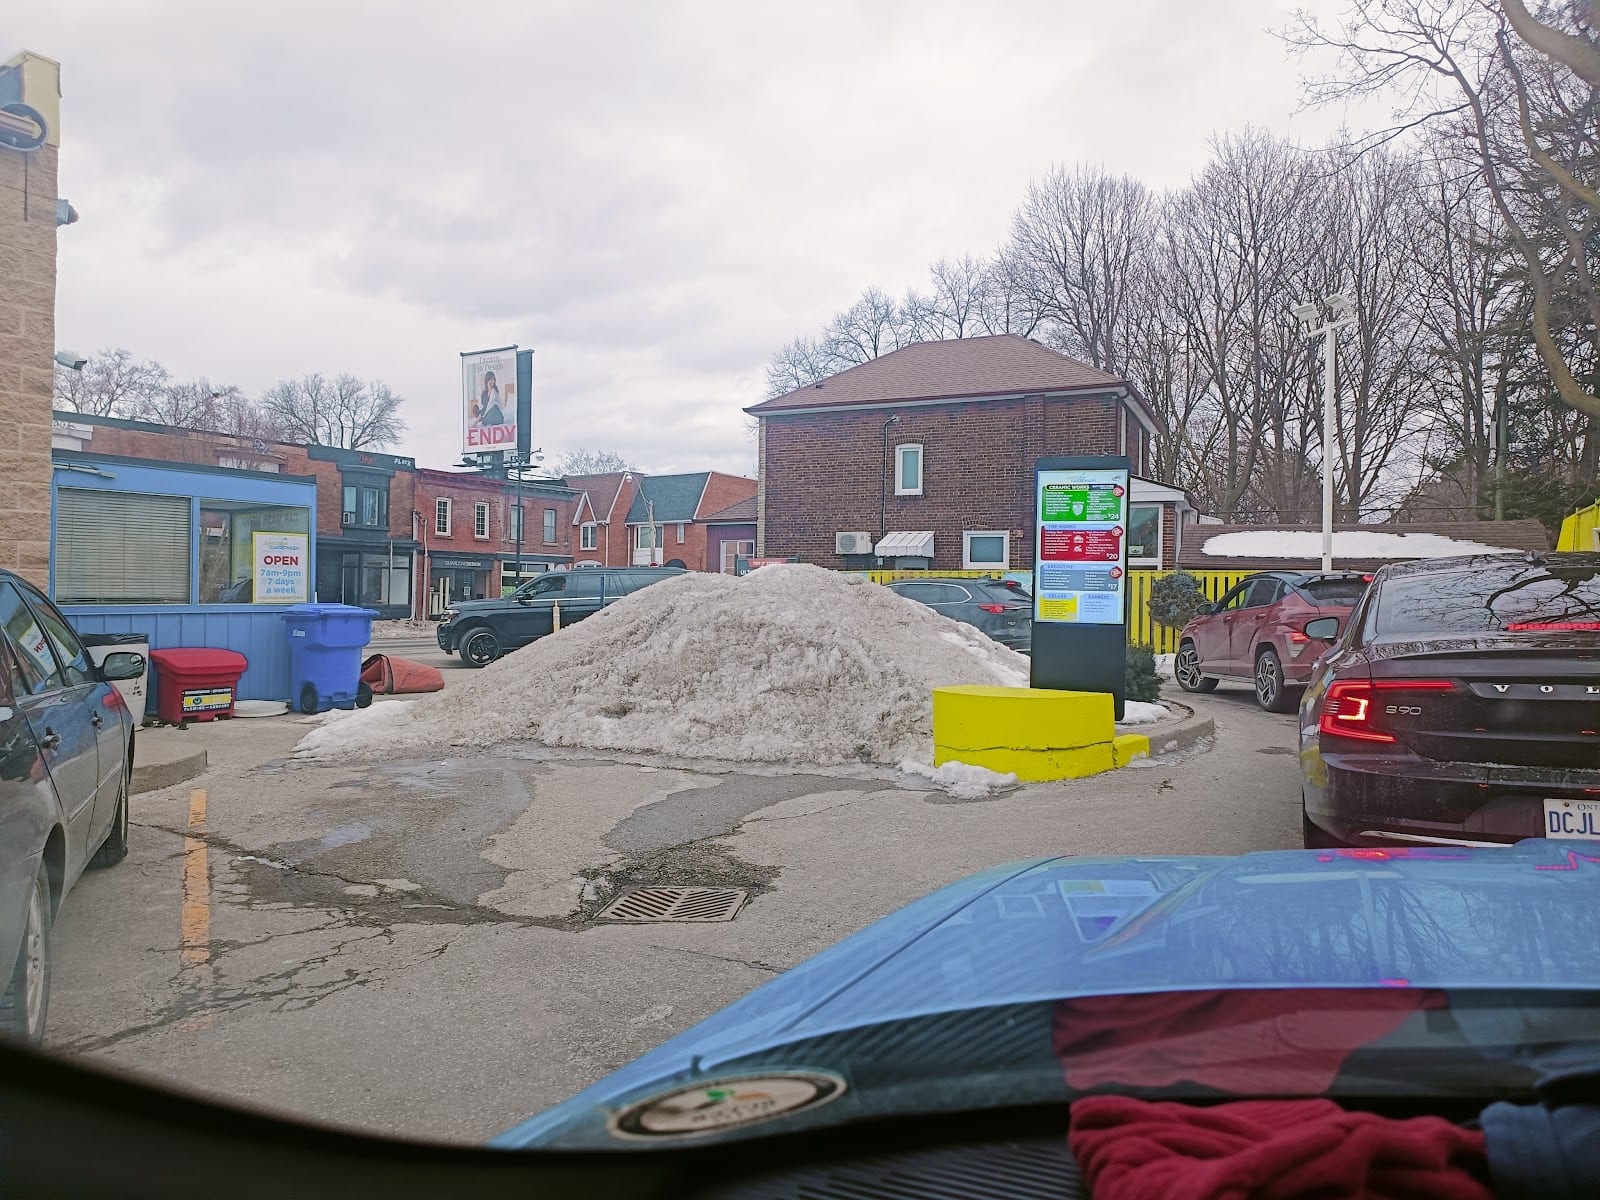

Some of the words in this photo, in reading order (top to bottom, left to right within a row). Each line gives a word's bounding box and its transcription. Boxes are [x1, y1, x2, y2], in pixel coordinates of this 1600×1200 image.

[467, 424, 516, 446] ENDY
[264, 555, 299, 566] OPEN
[260, 569, 301, 577] 7am-9pm
[275, 578, 294, 586] days
[1386, 705, 1422, 716] S90
